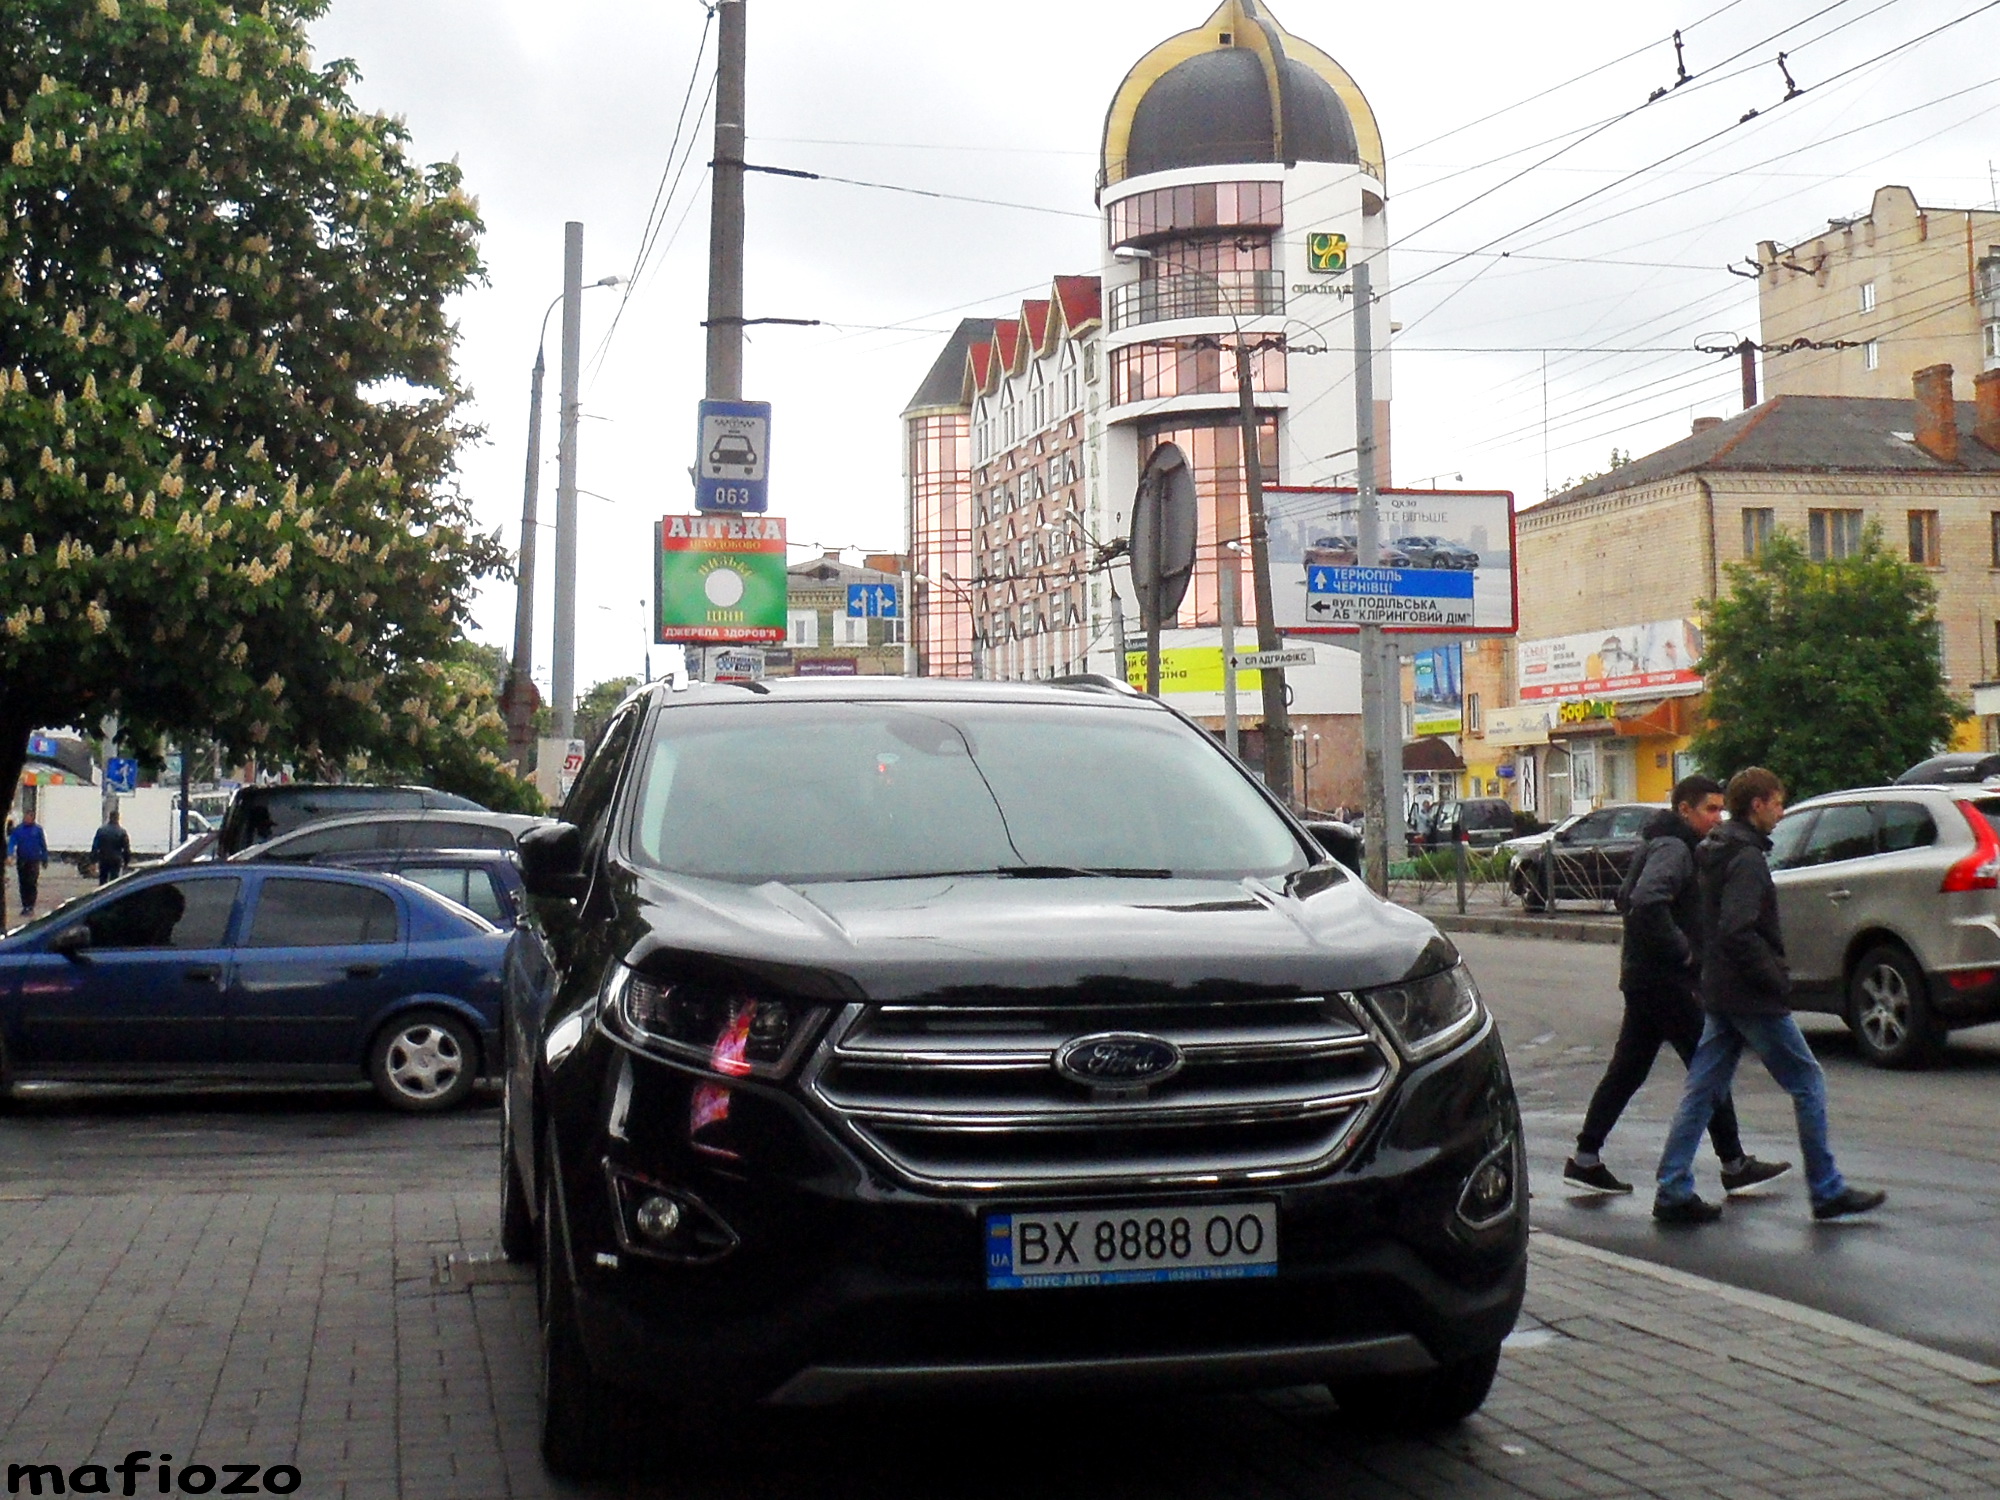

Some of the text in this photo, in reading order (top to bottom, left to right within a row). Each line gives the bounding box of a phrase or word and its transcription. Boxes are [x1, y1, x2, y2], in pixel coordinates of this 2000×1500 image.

[716, 487, 749, 504] 063
[668, 517, 782, 539] АПТЕКА
[1333, 568, 1402, 581] ТЕРНОПІЛЬ
[1332, 580, 1393, 595] ЧЕРНІВЦІ
[1332, 597, 1437, 611] вул. ПОДІЛЬСЬКА
[1332, 609, 1472, 625] АБ "КЛІРИНГОВИЙ ДІМ"
[665, 628, 777, 638] ДЖЕРЕЛА ЗДОРОВ'Я
[1245, 652, 1308, 666] СП АДГРАФІКС
[563, 755, 583, 770] 57
[1088, 1044, 1154, 1073] Ford
[1019, 1221, 1080, 1265] BX
[1094, 1217, 1192, 1263] 8888
[991, 1253, 1010, 1267] UA
